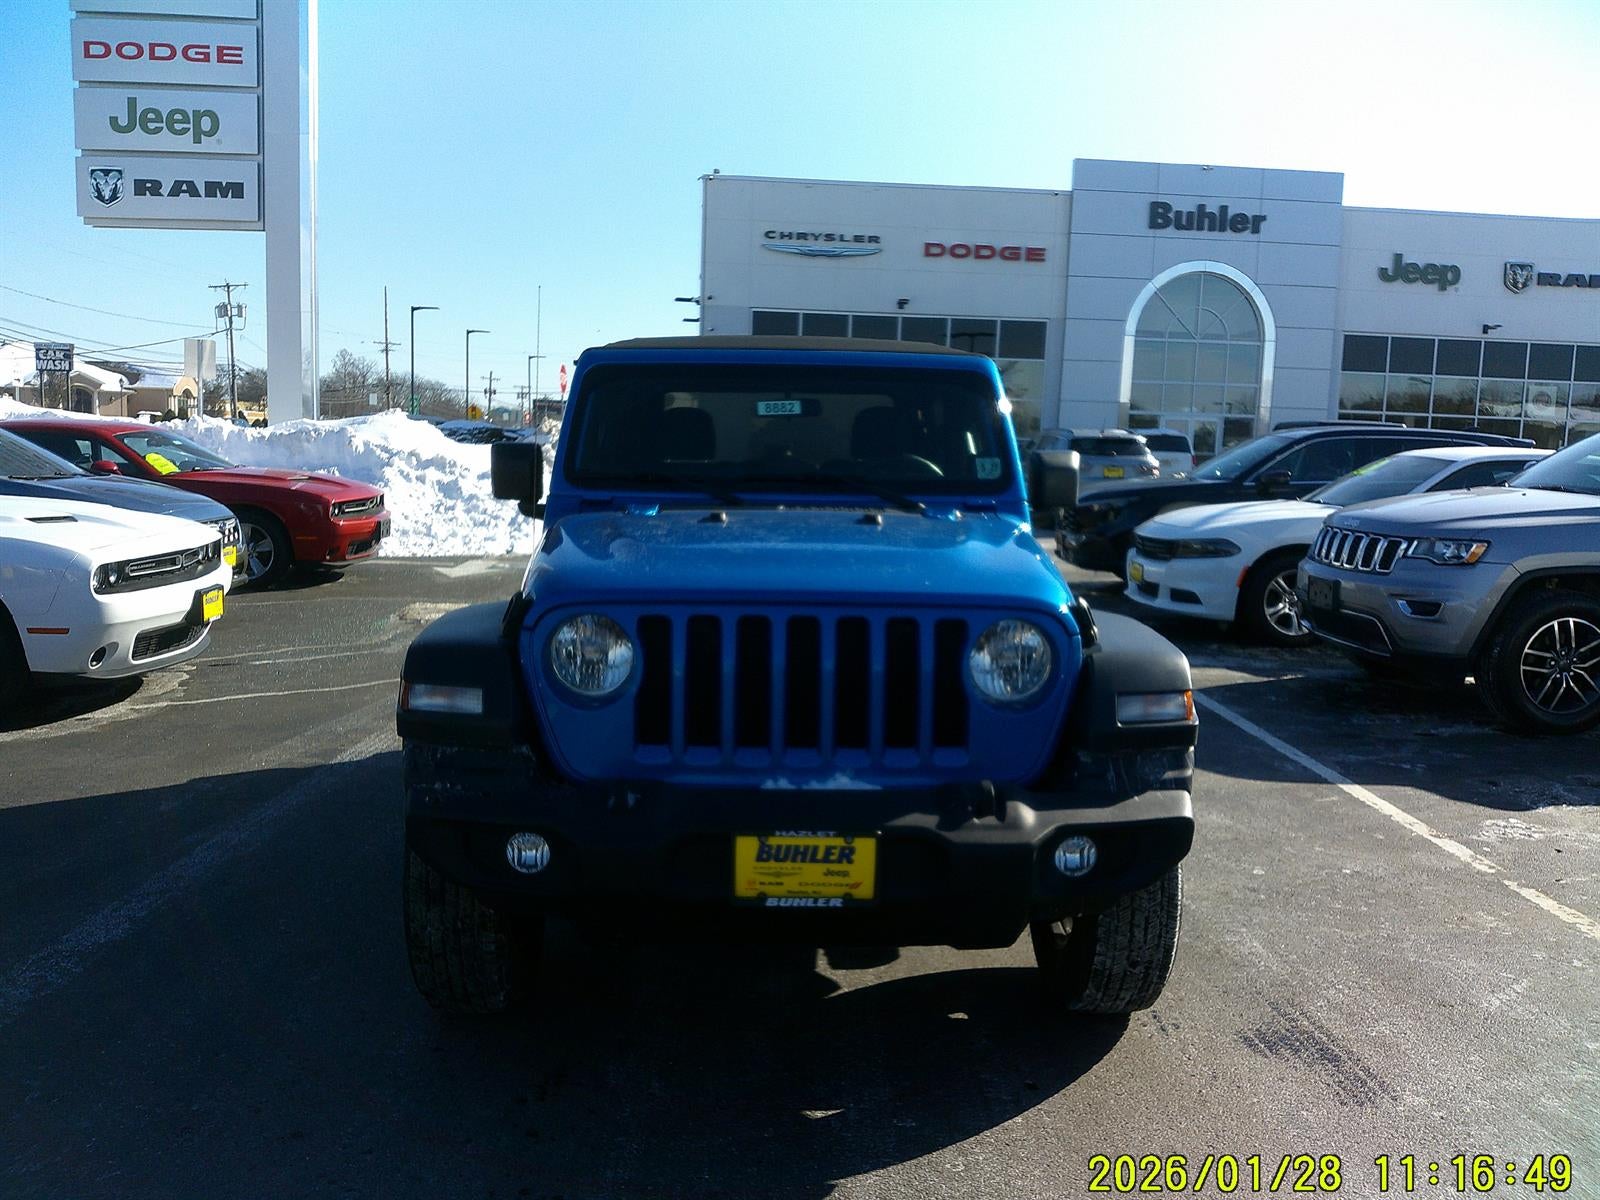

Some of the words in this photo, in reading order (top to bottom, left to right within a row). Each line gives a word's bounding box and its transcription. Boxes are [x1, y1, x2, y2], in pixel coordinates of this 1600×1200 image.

[83, 40, 244, 65] DODGE
[109, 96, 220, 144] Jeep
[133, 178, 245, 199] RAM
[1149, 201, 1267, 234] Buhler
[764, 230, 881, 244] CHRYSLER
[924, 242, 1047, 262] DODGE
[1378, 253, 1461, 291] Jeep
[36, 360, 69, 370] WASH
[38, 349, 65, 360] CAR
[756, 844, 856, 865] BUHLER
[765, 897, 845, 908] BUHLER
